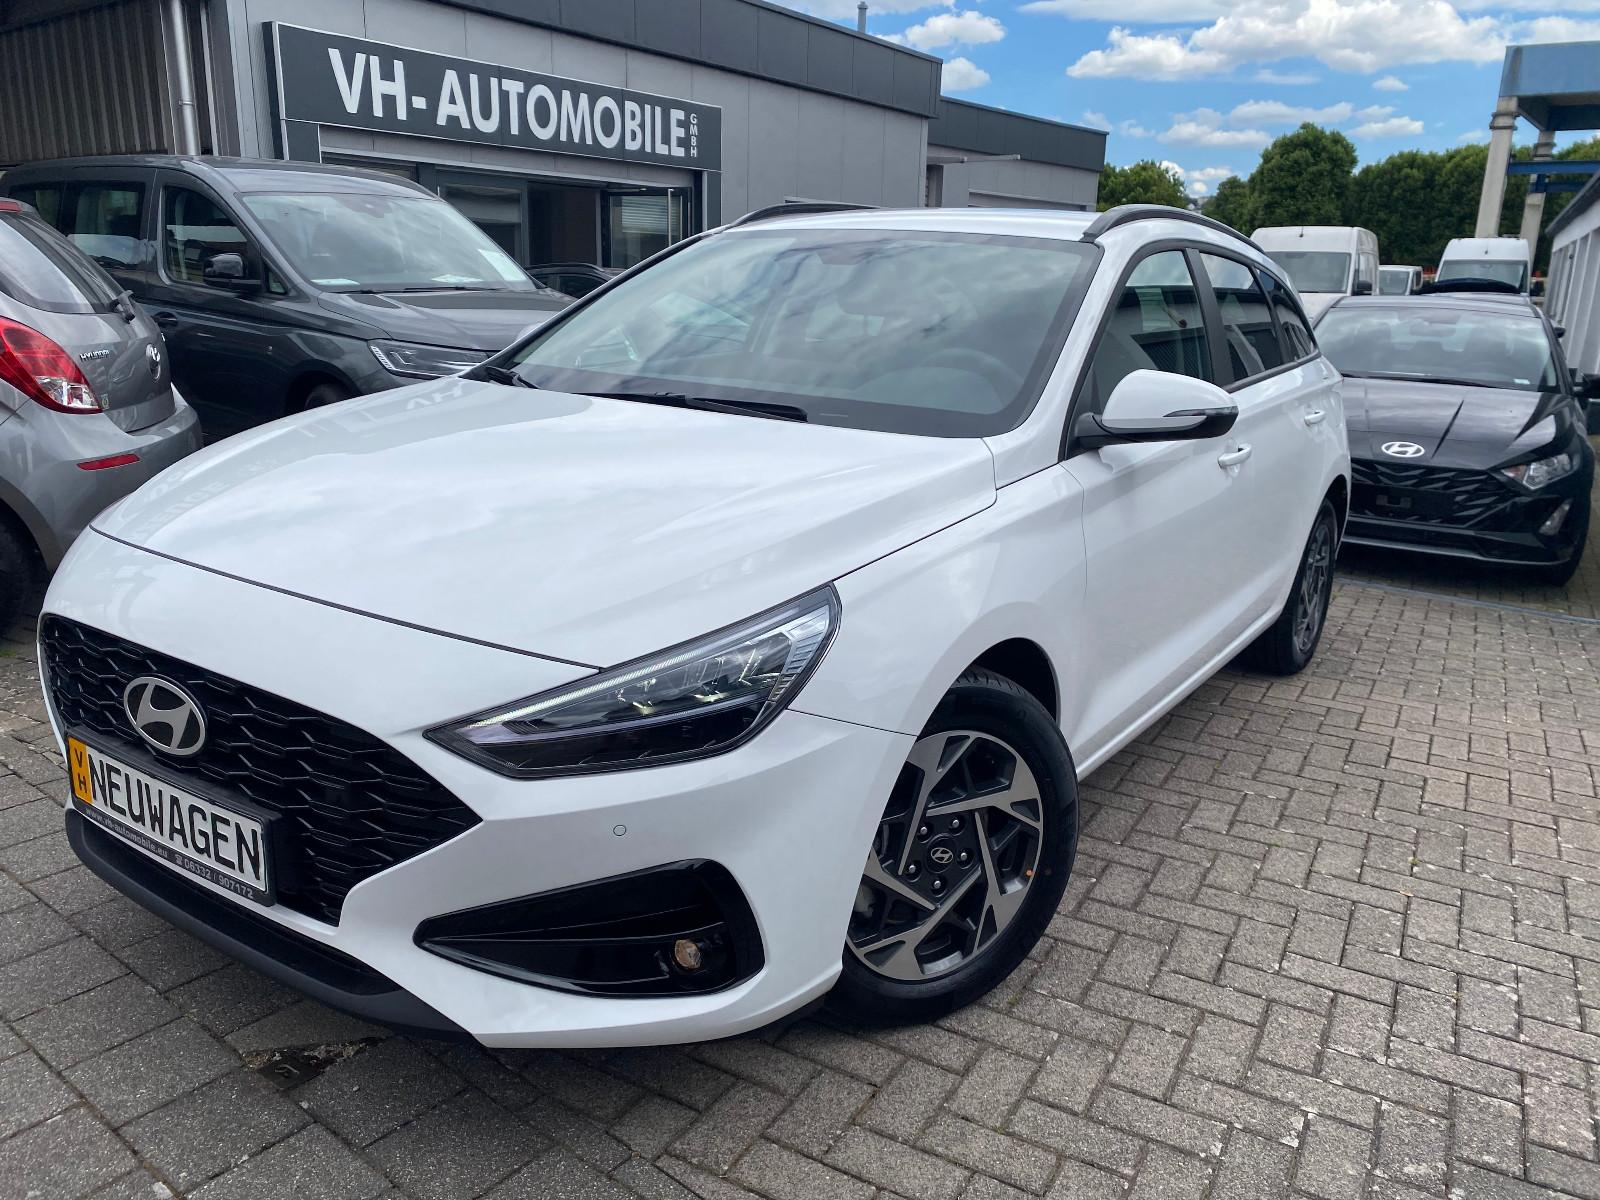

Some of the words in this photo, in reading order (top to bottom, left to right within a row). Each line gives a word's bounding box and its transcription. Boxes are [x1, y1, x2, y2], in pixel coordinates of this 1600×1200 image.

[436, 69, 686, 157] AUTOMOBILE
[689, 113, 698, 158] GMBH
[79, 349, 110, 360] HYUNDAI
[85, 807, 168, 858] www.vh-automobile.eu
[184, 859, 212, 880] 06332
[218, 876, 254, 900] 907172
[87, 753, 262, 881] NEUWAGEN
